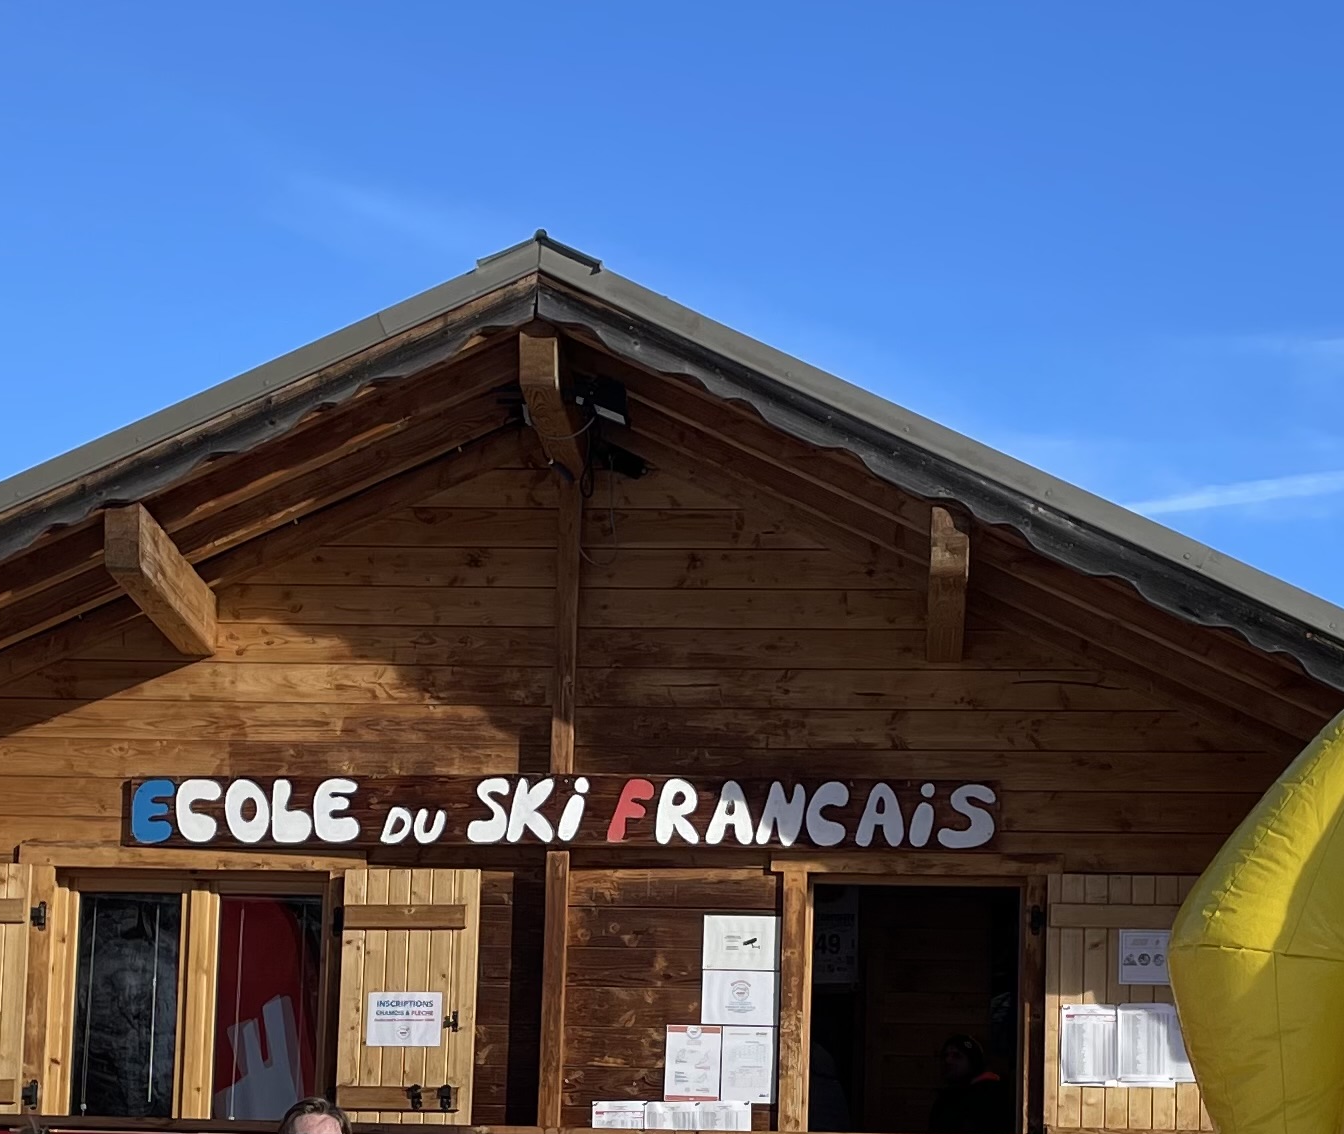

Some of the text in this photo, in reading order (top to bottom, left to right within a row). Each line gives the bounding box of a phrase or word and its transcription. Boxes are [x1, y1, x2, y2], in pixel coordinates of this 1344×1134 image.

[131, 778, 361, 844] ECOLE
[379, 806, 448, 844] DU
[376, 999, 434, 1008] INSCRIPTIONS
